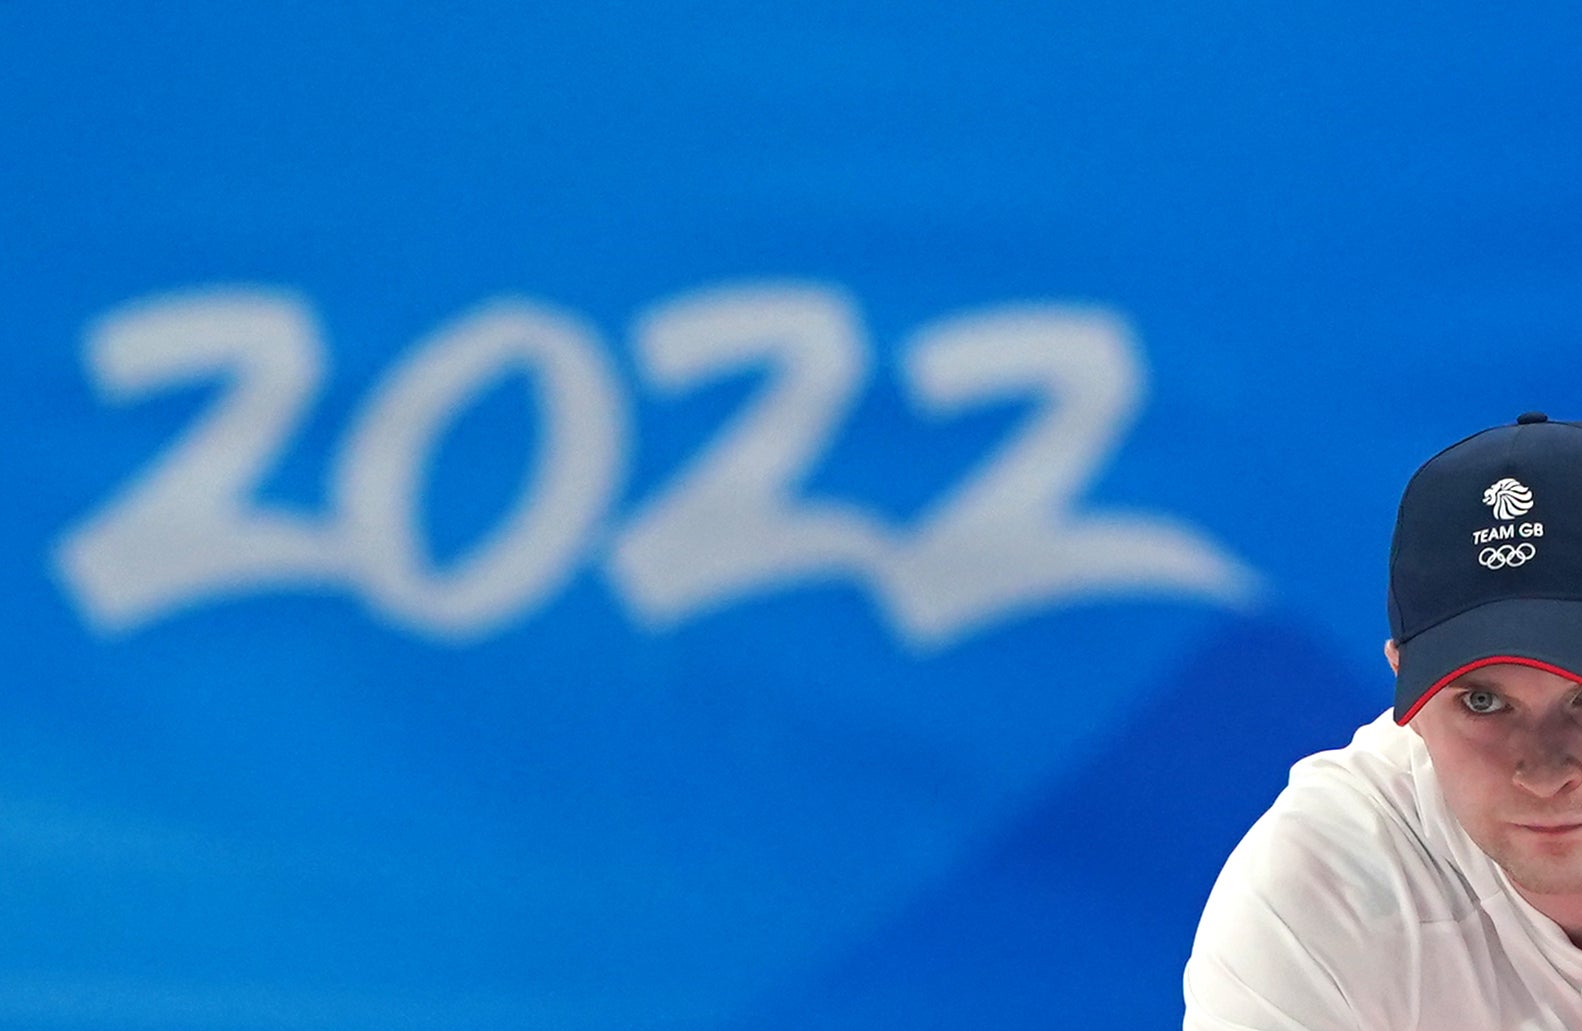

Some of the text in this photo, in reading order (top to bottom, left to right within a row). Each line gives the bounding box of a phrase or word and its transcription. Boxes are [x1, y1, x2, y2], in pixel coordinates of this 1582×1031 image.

[52, 282, 1264, 650] 2022
[1472, 522, 1544, 545] TEAM GB
